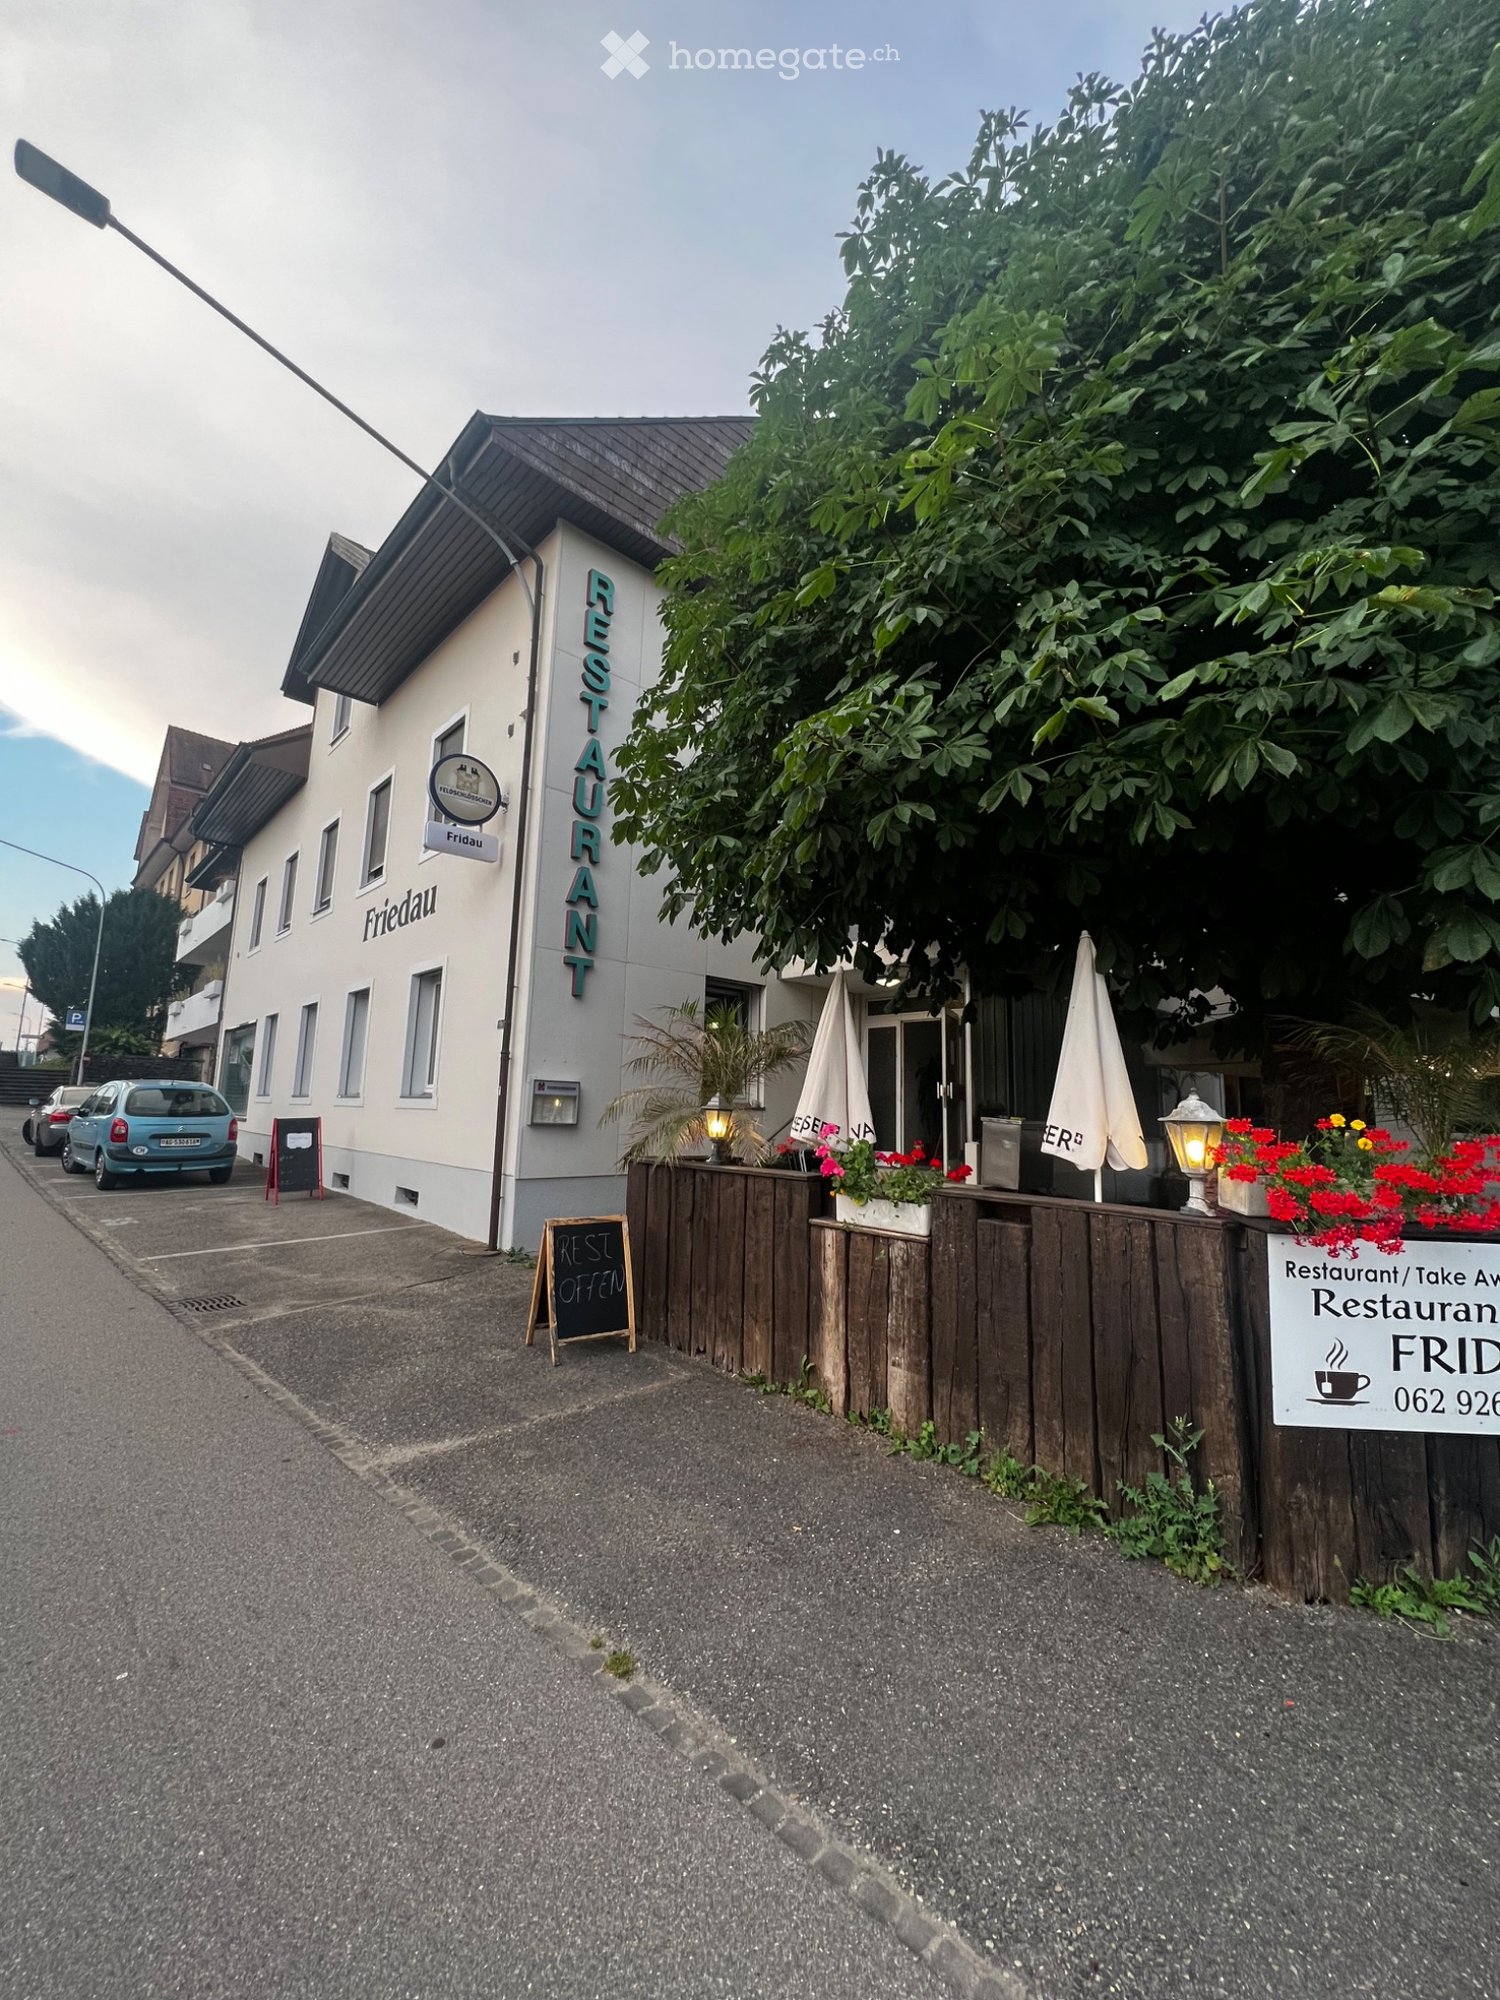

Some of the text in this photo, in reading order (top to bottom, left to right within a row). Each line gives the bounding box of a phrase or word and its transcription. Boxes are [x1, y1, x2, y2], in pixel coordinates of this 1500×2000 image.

[563, 568, 615, 998] RESTAURANT
[446, 831, 483, 848] Fridau
[362, 884, 438, 942] Friedau
[71, 1012, 82, 1024] P
[559, 1264, 626, 1304] OFFEN
[1416, 1266, 1467, 1286] Take
[1391, 1334, 1500, 1375] FRID
[1394, 1386, 1446, 1414] 062
